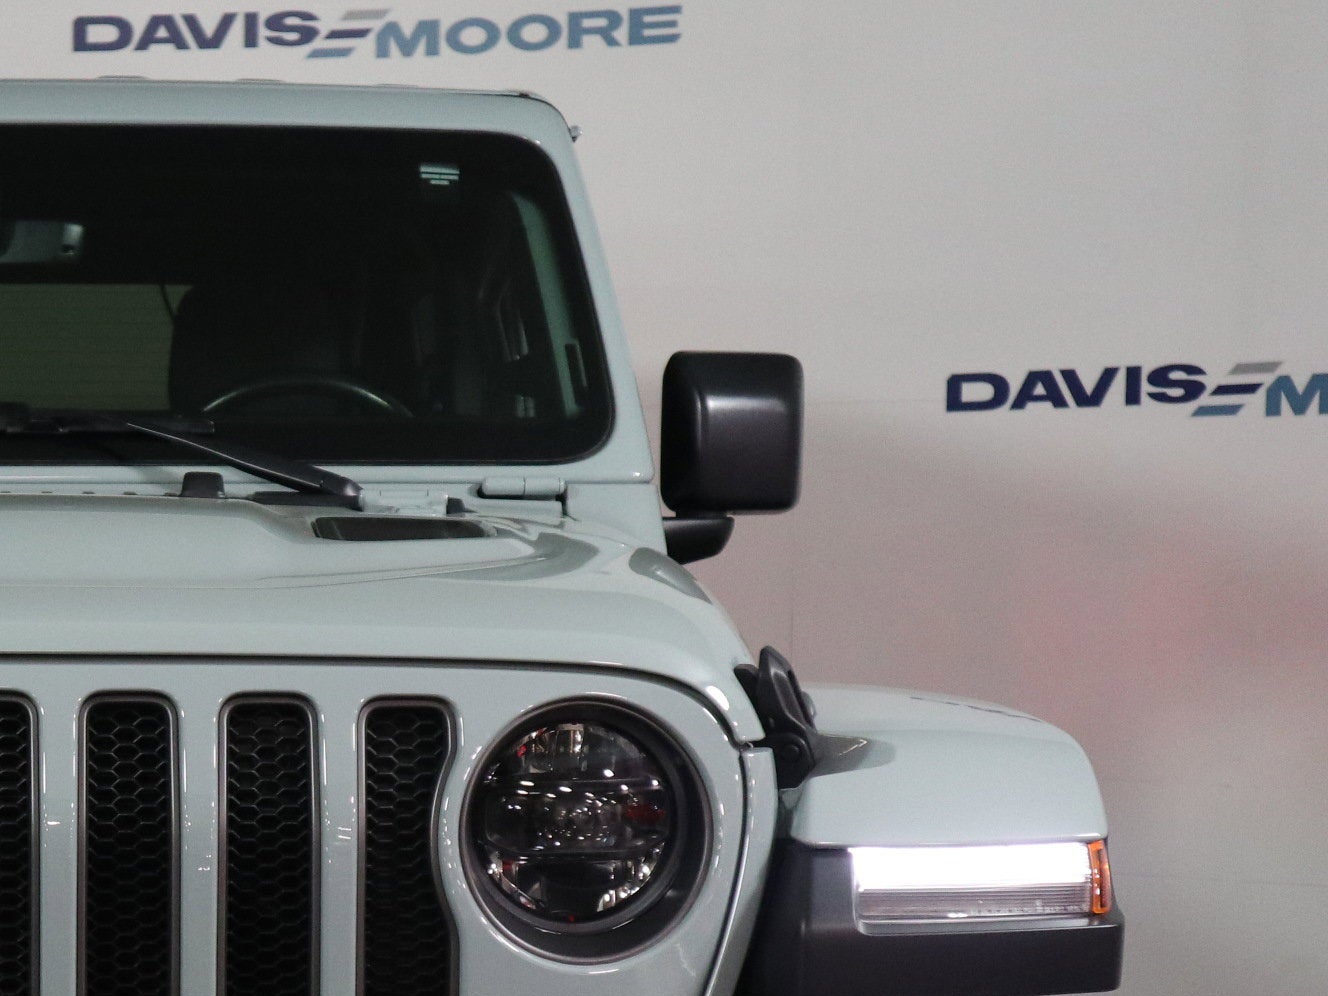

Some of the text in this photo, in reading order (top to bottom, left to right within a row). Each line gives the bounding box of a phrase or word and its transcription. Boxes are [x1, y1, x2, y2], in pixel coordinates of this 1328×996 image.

[72, 5, 683, 59] DAVIS MOORE
[945, 363, 1208, 413] DAVIS
